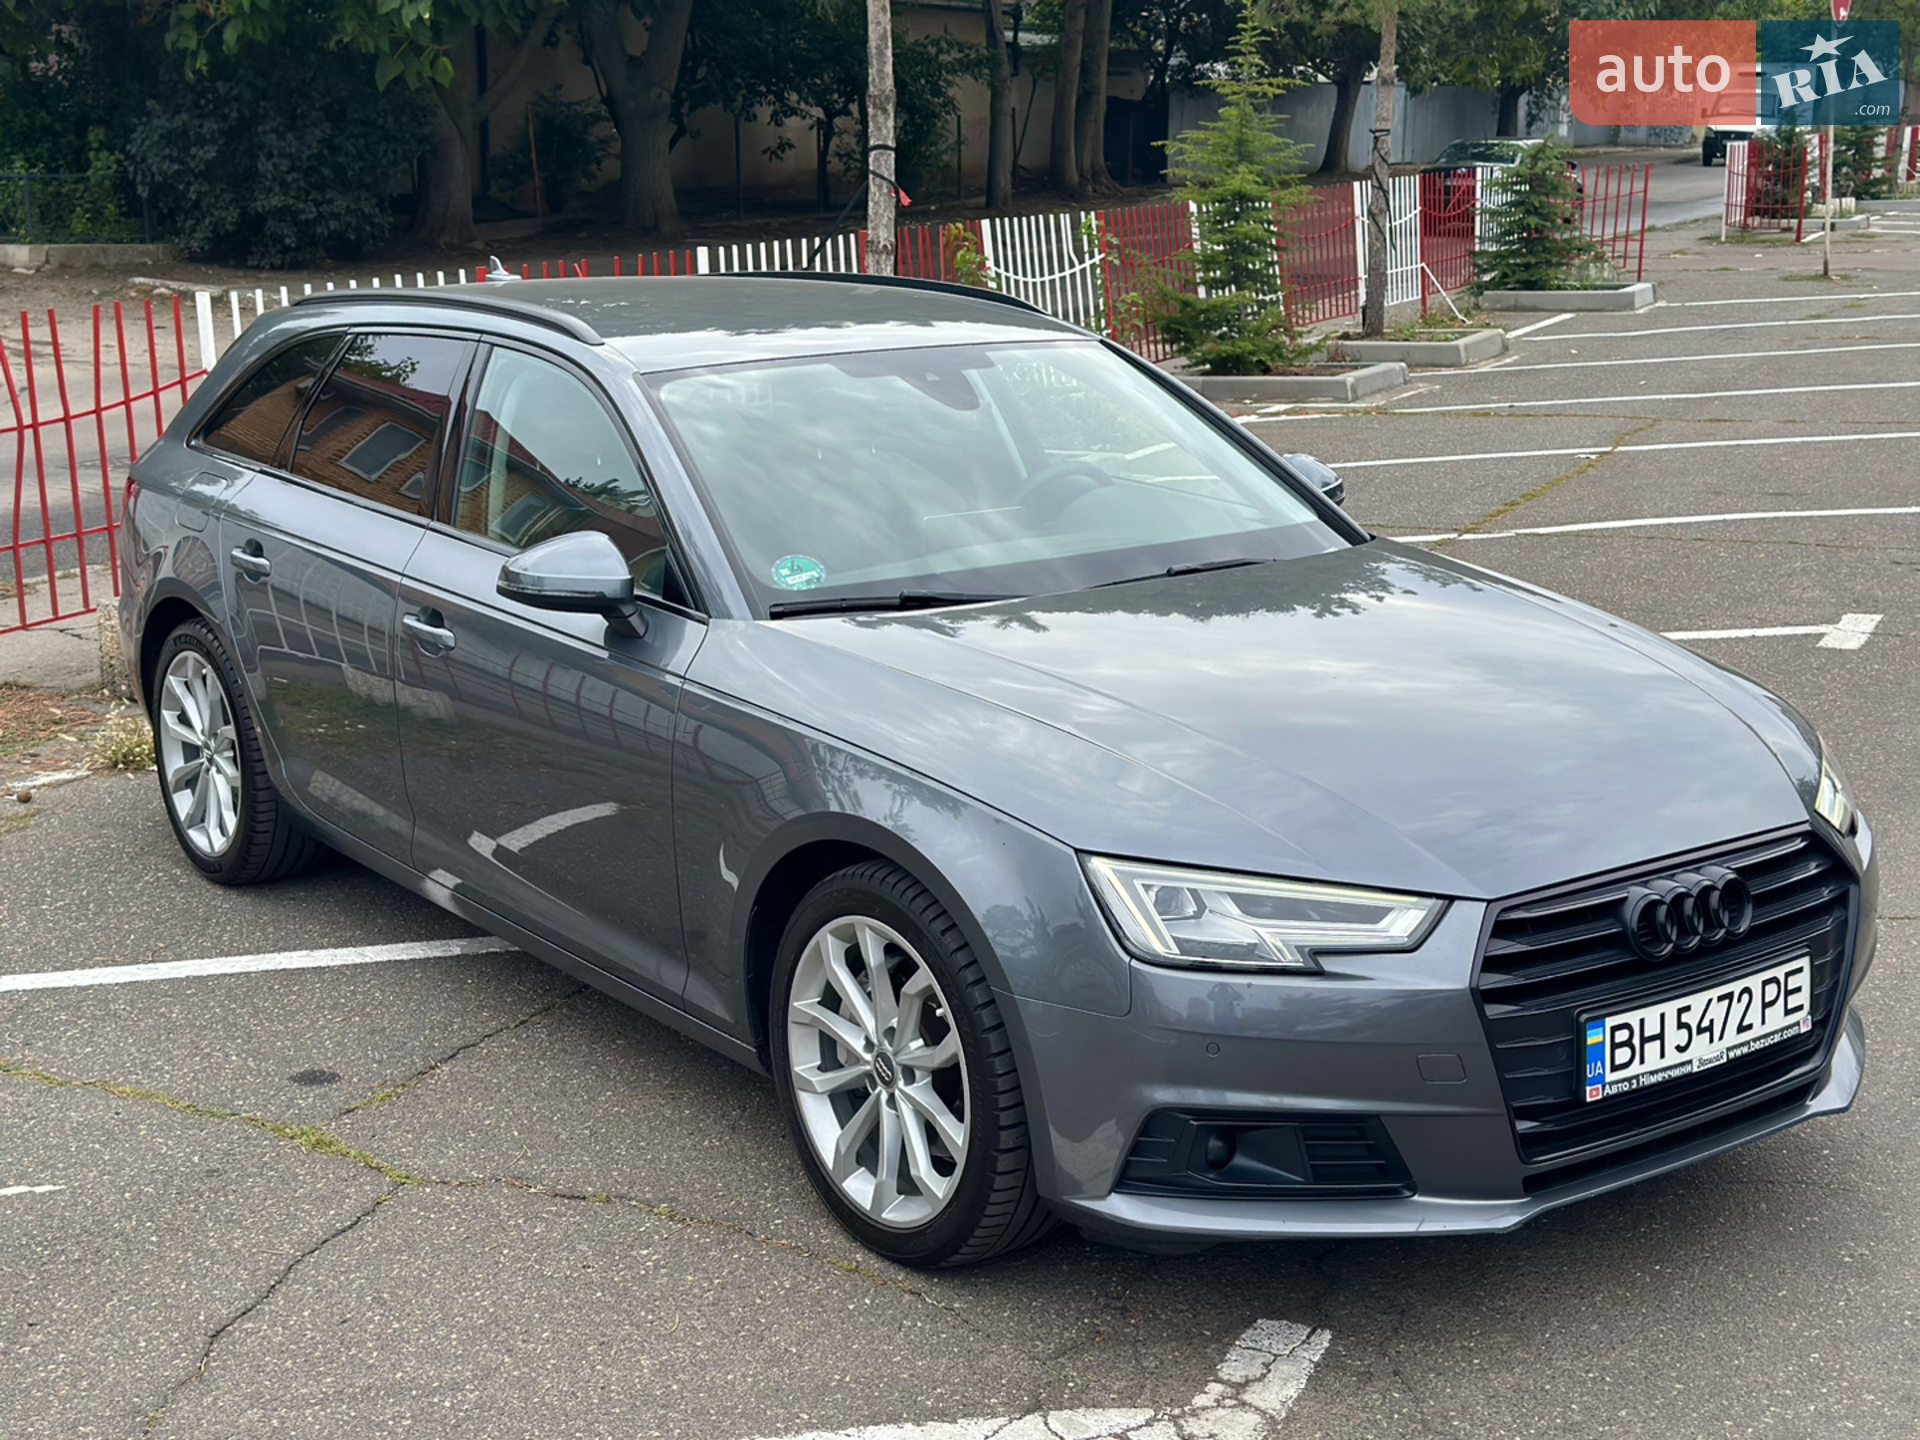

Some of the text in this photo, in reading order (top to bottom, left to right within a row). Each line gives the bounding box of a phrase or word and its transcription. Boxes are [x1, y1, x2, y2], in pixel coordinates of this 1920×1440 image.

[1609, 966, 1805, 1074] BH 5472 PE
[1727, 1024, 1800, 1060] www.bezucar.com
[1586, 1060, 1604, 1078] UA
[1603, 1081, 1630, 1097] Авто
[1639, 1062, 1692, 1087] Німеччини
